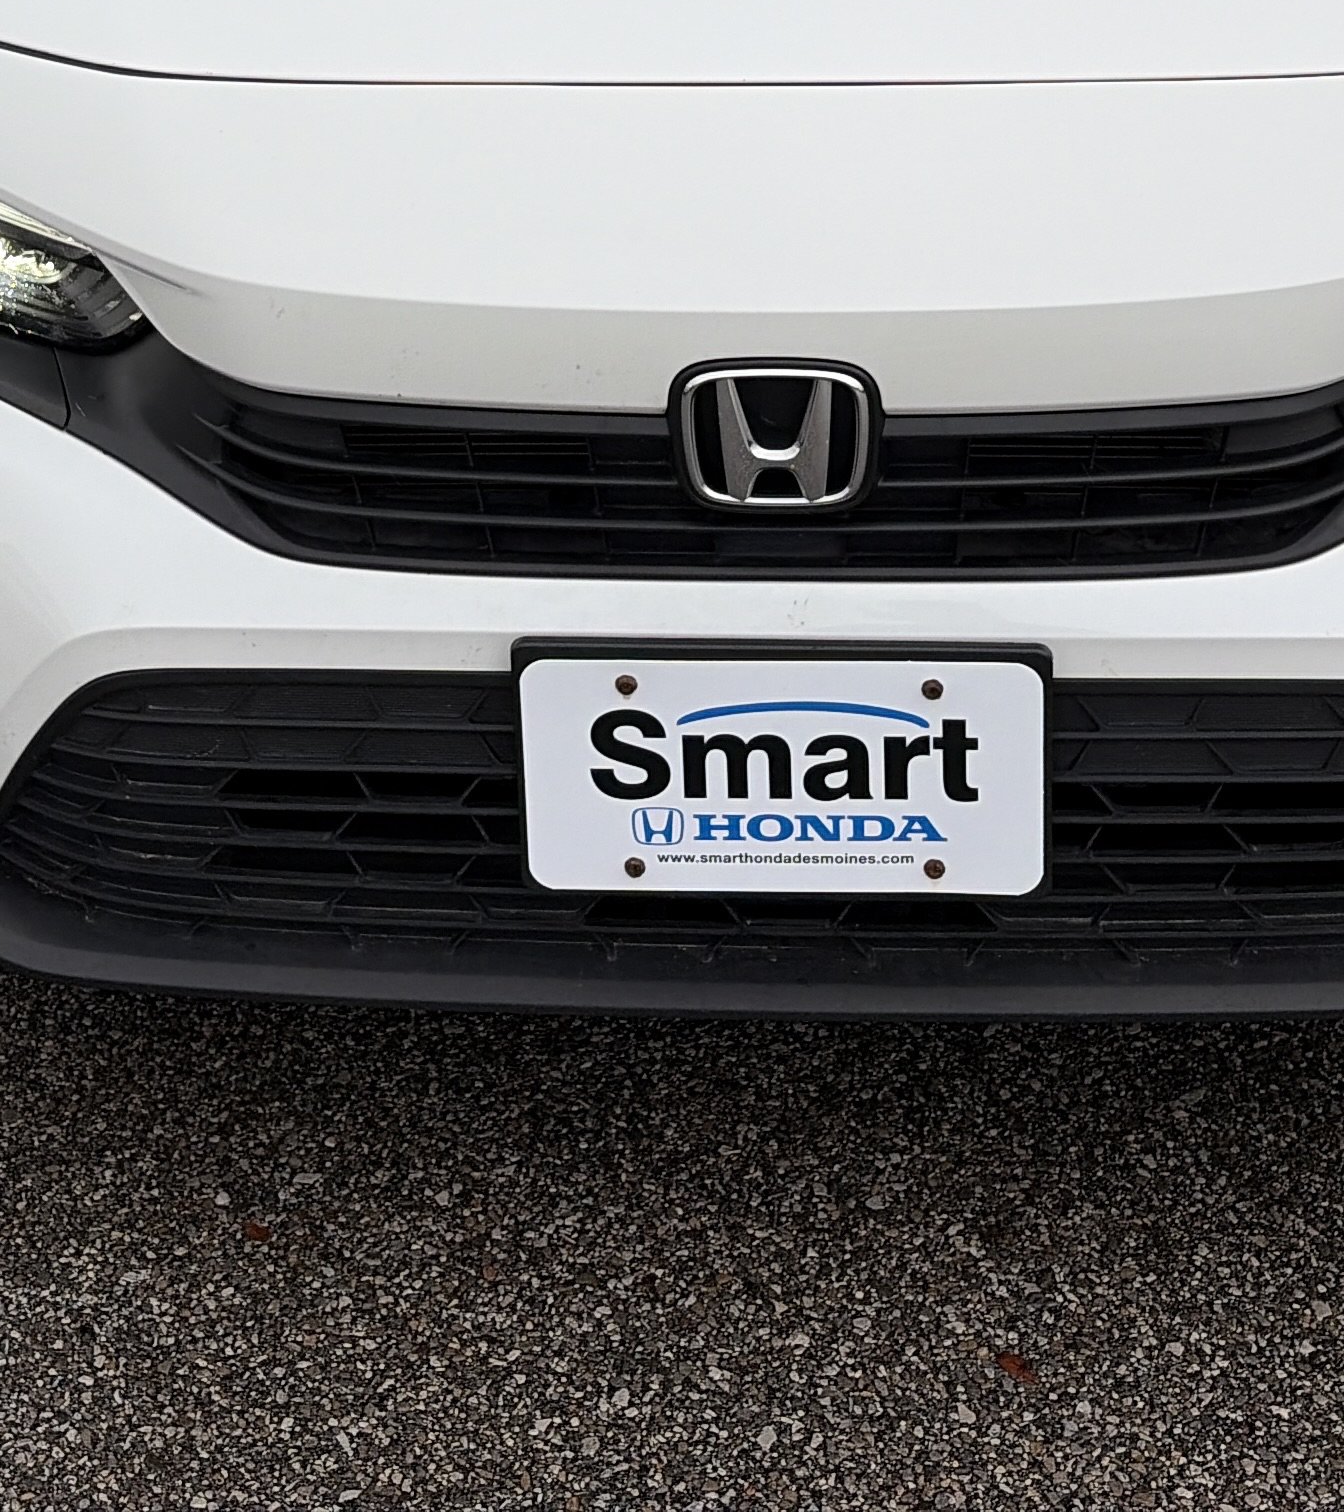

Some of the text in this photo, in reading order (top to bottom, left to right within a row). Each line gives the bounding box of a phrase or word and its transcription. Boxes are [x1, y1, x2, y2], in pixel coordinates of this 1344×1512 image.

[589, 707, 979, 803] Smart
[693, 813, 947, 842] HONDA
[656, 853, 915, 865] www.smarthondadesmoines.com
